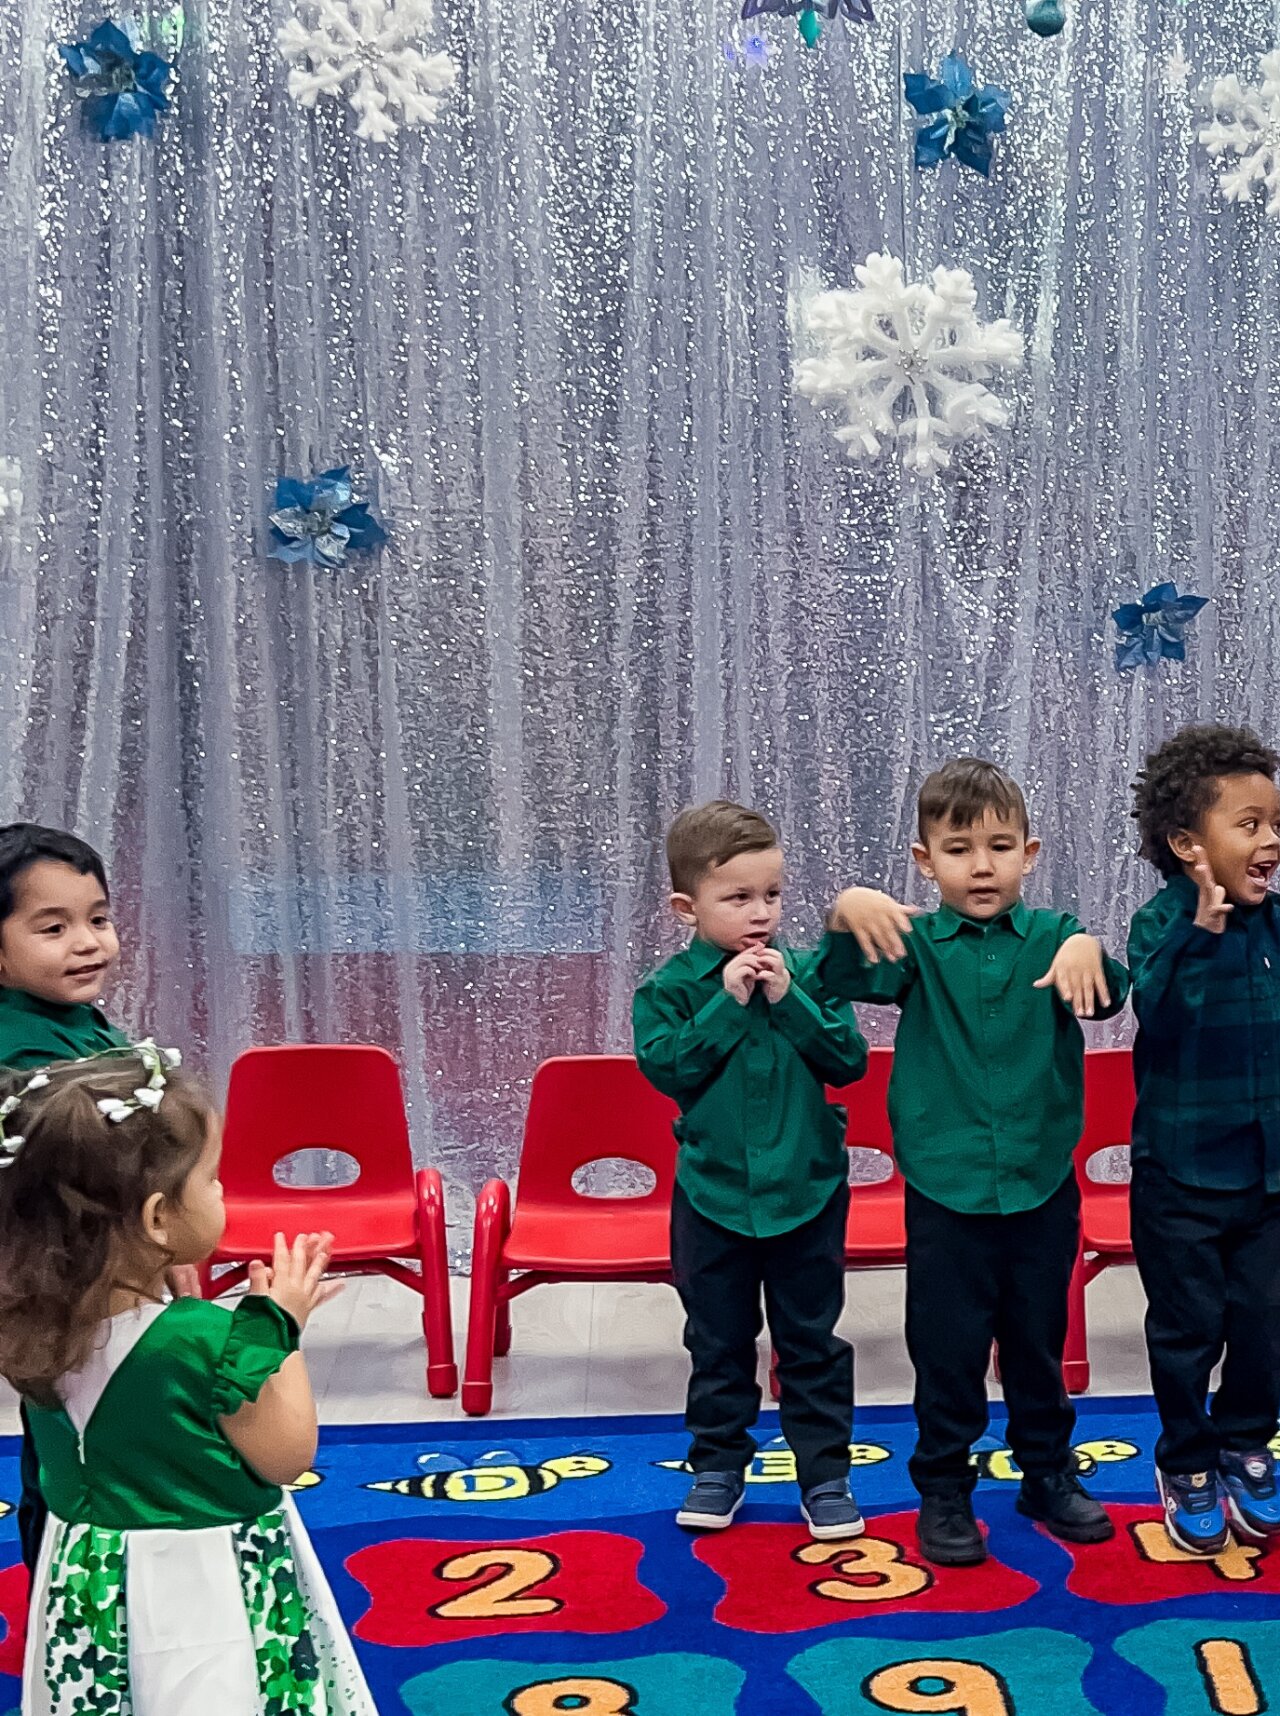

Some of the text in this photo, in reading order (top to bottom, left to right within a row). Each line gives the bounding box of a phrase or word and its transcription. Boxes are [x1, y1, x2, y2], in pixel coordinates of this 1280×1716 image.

[463, 1474, 516, 1492] D
[751, 1457, 791, 1476] E
[791, 1535, 934, 1602] 3
[1127, 1519, 1267, 1581] 4
[428, 1547, 564, 1620] 2
[861, 1658, 1015, 1716] 9
